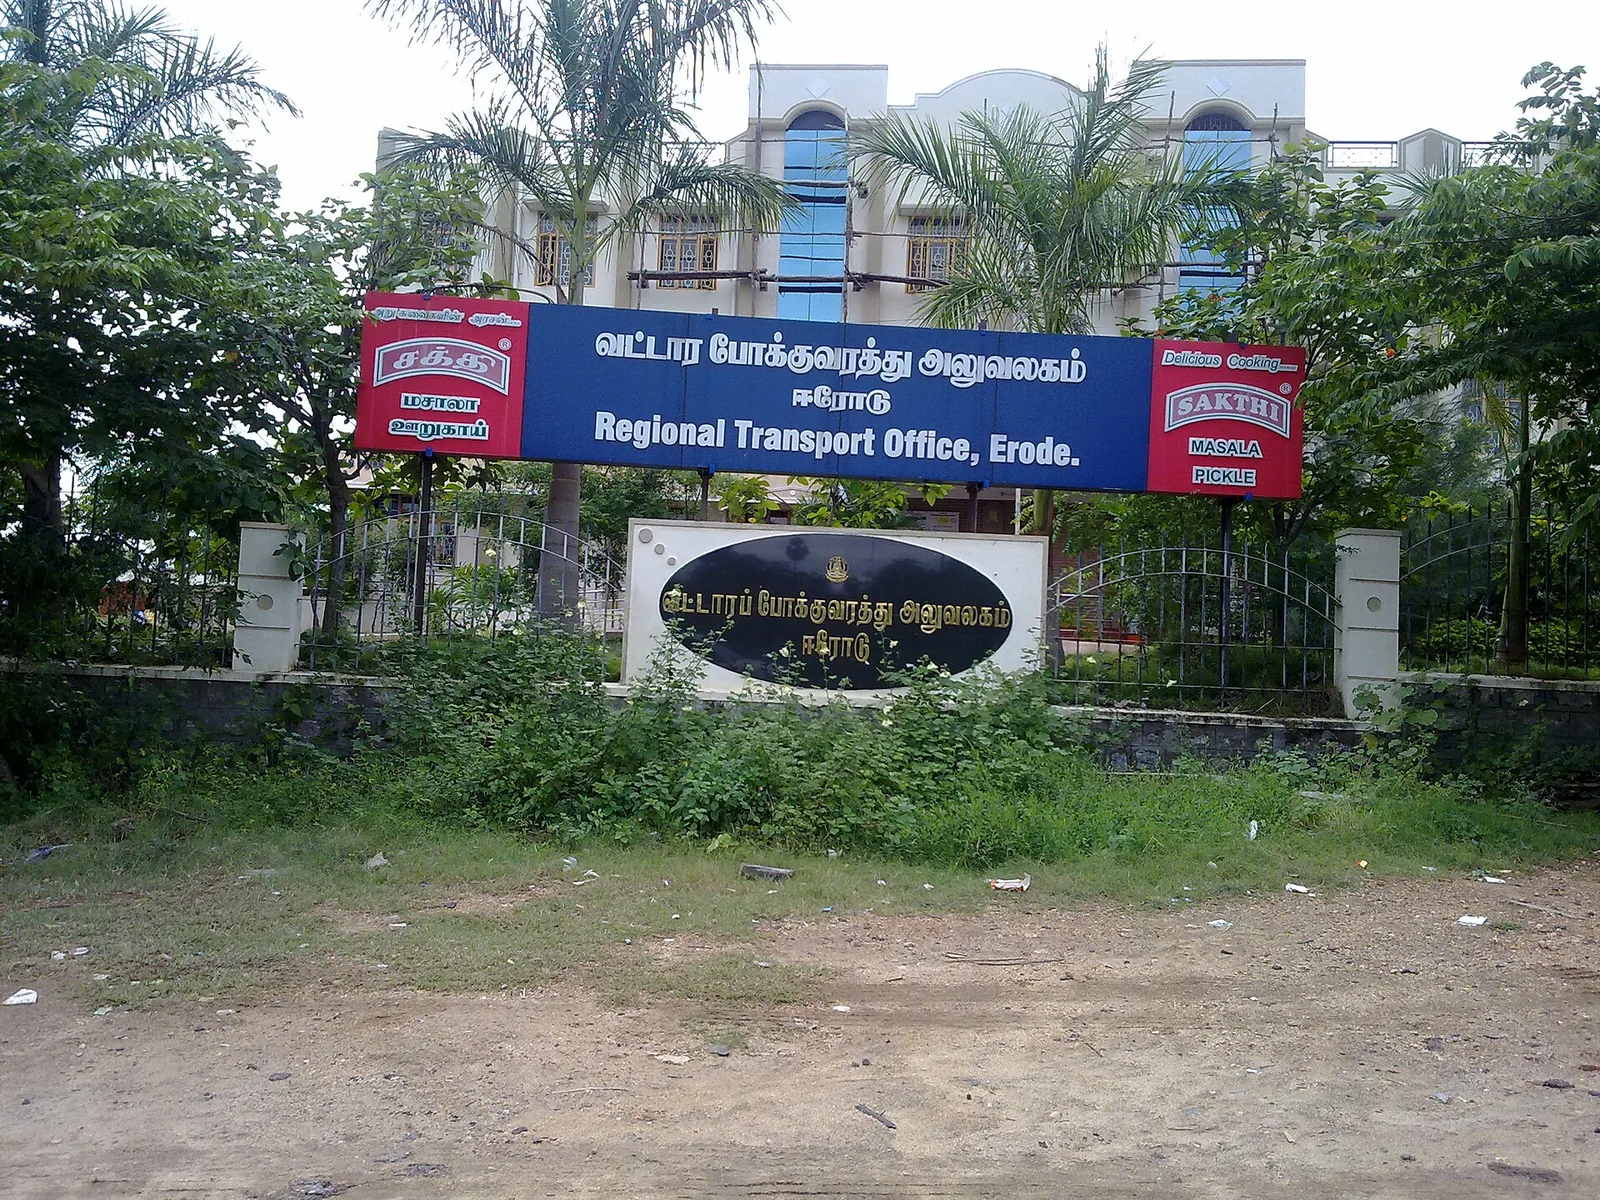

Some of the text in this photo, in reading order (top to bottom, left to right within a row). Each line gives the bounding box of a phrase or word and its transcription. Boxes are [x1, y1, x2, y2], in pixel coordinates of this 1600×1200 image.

[393, 346, 495, 373] சக்தி
[595, 330, 1087, 388] வட்டார போக்குவரத்து அலுவலகம்
[1164, 351, 1221, 367] Delicious
[403, 395, 478, 411] மசாலா
[792, 385, 891, 415] ஈரோடு
[1178, 393, 1280, 422] SAKTHI
[391, 420, 487, 438] ஊறுகாய்
[595, 411, 1080, 467] Regional Transport Office, Erode.
[1191, 440, 1260, 456] MASALA
[1195, 469, 1255, 484] PICKLE
[757, 589, 893, 630] போக்குவரத்து
[899, 599, 1010, 634] அலுவலகம்
[802, 629, 870, 662] ஈரோடு
